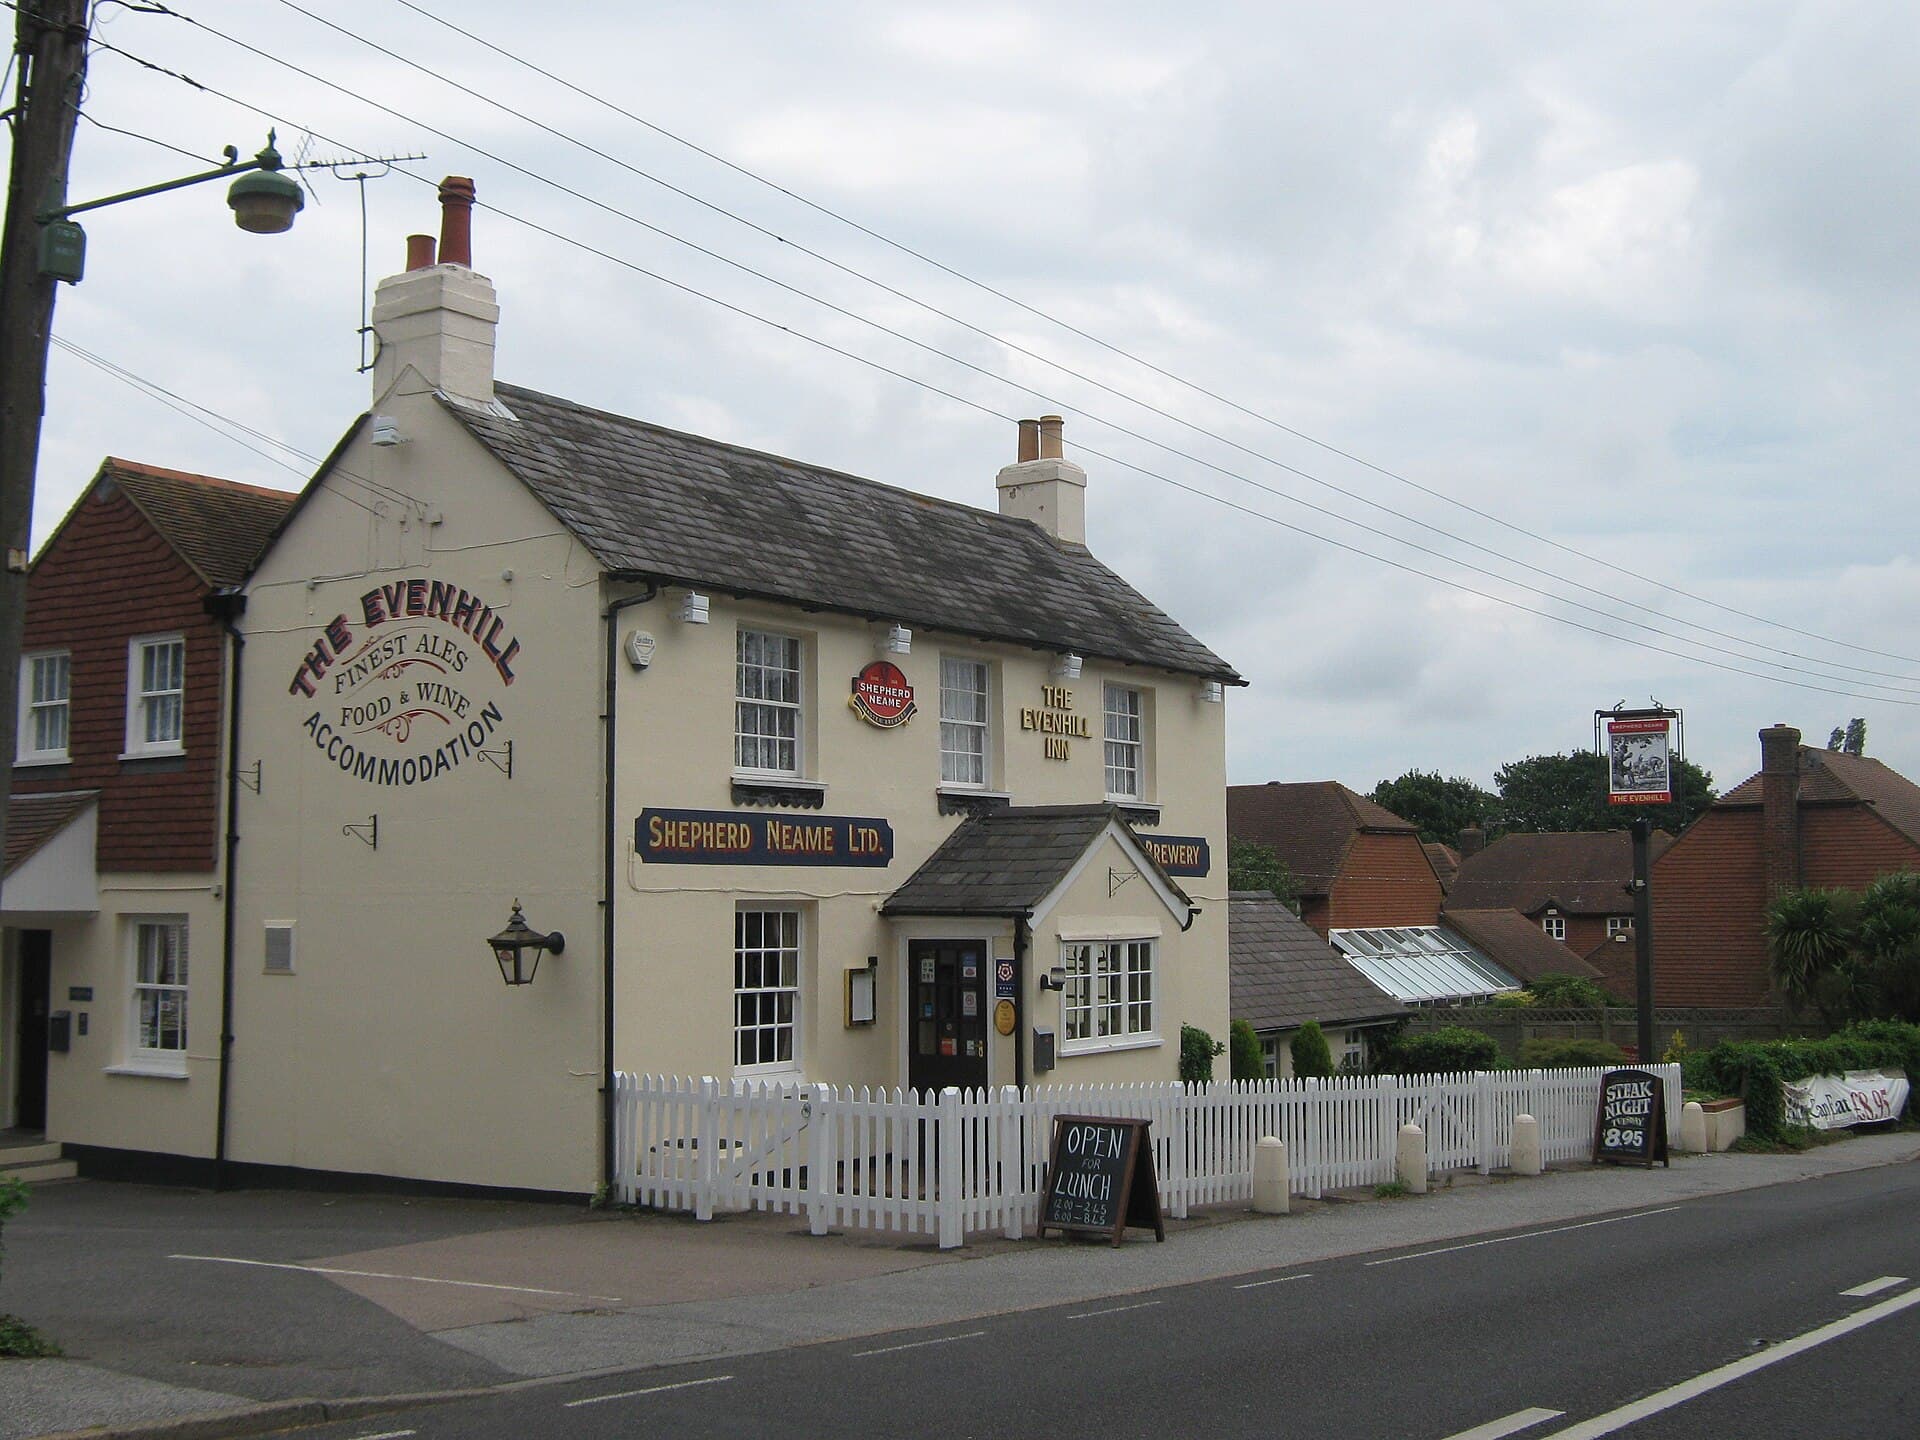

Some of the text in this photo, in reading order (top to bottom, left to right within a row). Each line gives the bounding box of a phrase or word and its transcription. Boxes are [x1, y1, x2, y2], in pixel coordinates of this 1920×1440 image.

[288, 579, 520, 698] THE EVENHILL
[334, 634, 468, 694] FINEST ALES
[860, 682, 911, 699] SHEPHERD
[869, 695, 902, 708] NEAME
[1042, 685, 1073, 710] THE
[340, 682, 470, 727] FOOD & WINE
[1021, 708, 1092, 739] EVENHILL
[303, 701, 503, 786] ACCOMMODATION
[1045, 737, 1071, 761] INN
[1630, 793, 1665, 802] EVENHILL
[650, 816, 751, 850] SHEPHERD
[767, 820, 834, 852] NEAME
[1606, 1081, 1653, 1103] STEAK
[1604, 1098, 1651, 1120] NIGHT
[1067, 1126, 1123, 1159] OPEN
[1081, 1158, 1101, 1170] FOR
[1055, 1171, 1111, 1201] LUNCH
